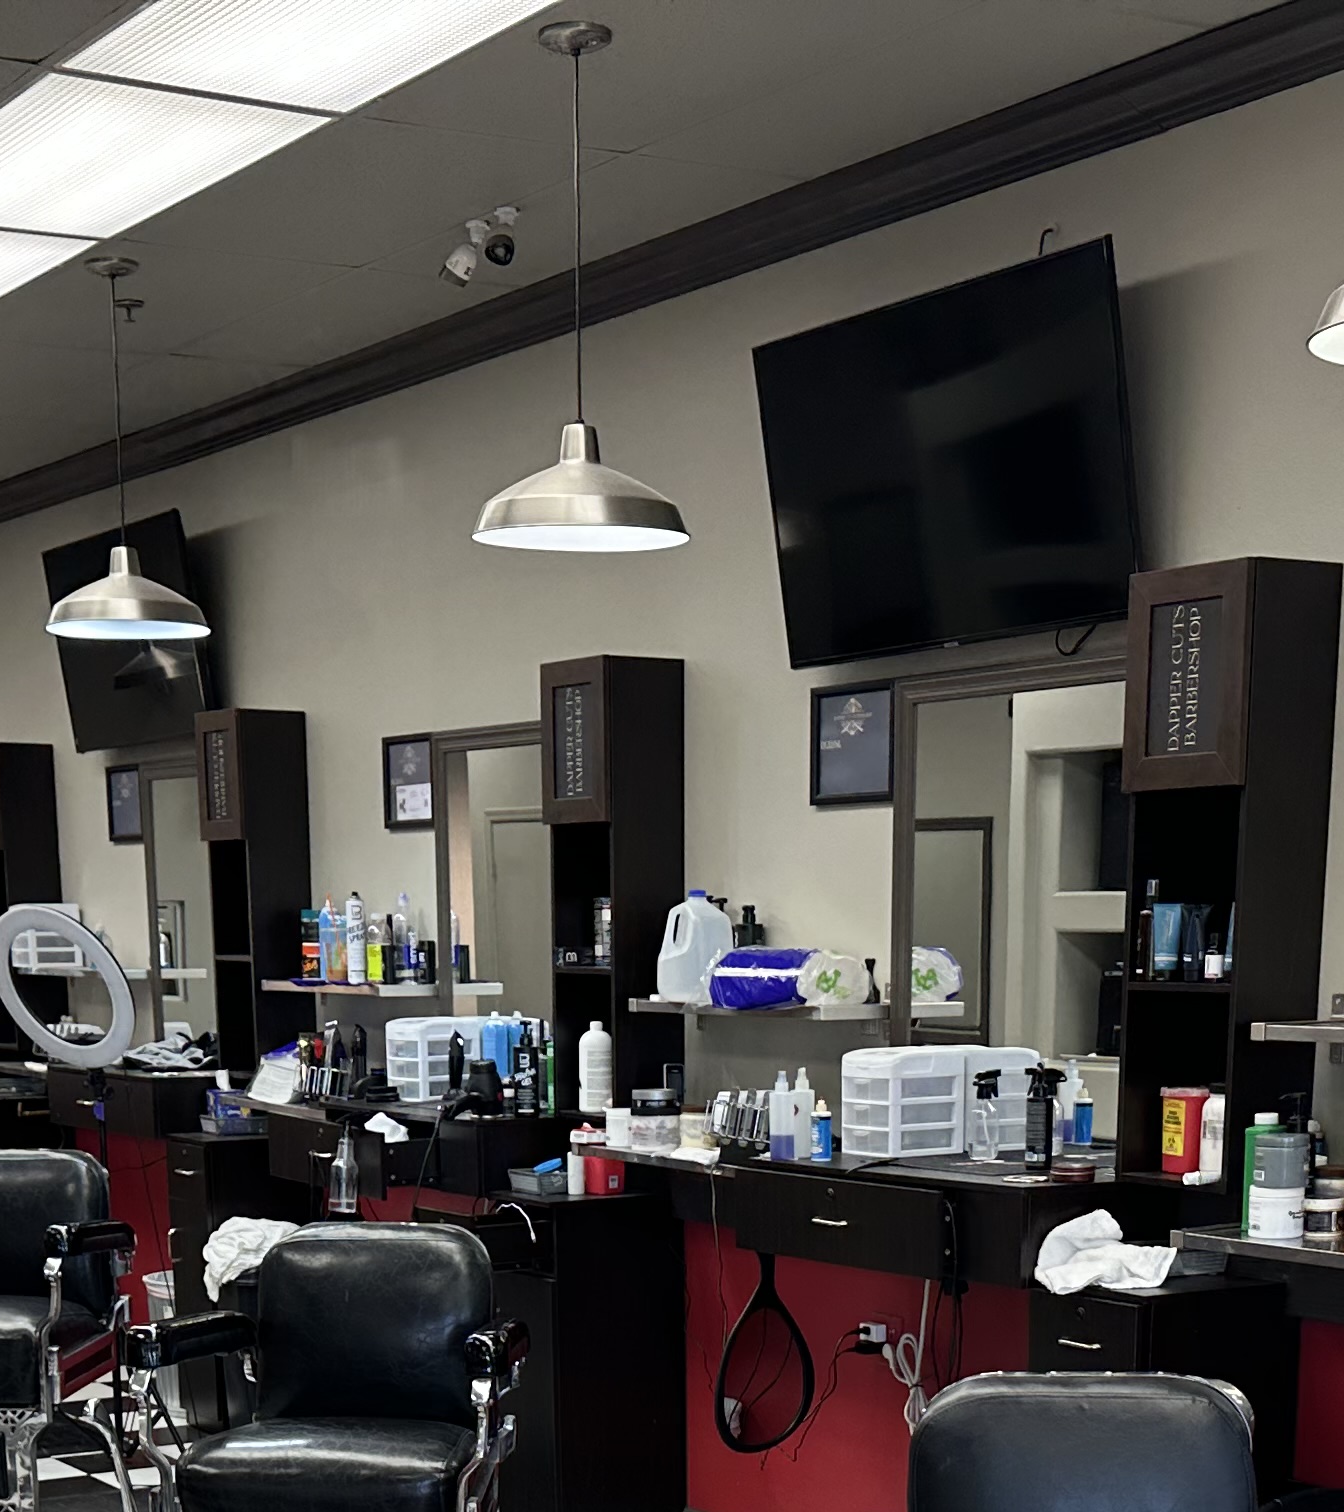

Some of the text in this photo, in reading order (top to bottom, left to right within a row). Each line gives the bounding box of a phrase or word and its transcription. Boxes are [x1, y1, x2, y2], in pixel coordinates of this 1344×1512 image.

[1167, 604, 1185, 752] DAPPER CUTS
[1184, 607, 1202, 746] BARBERSHOP
